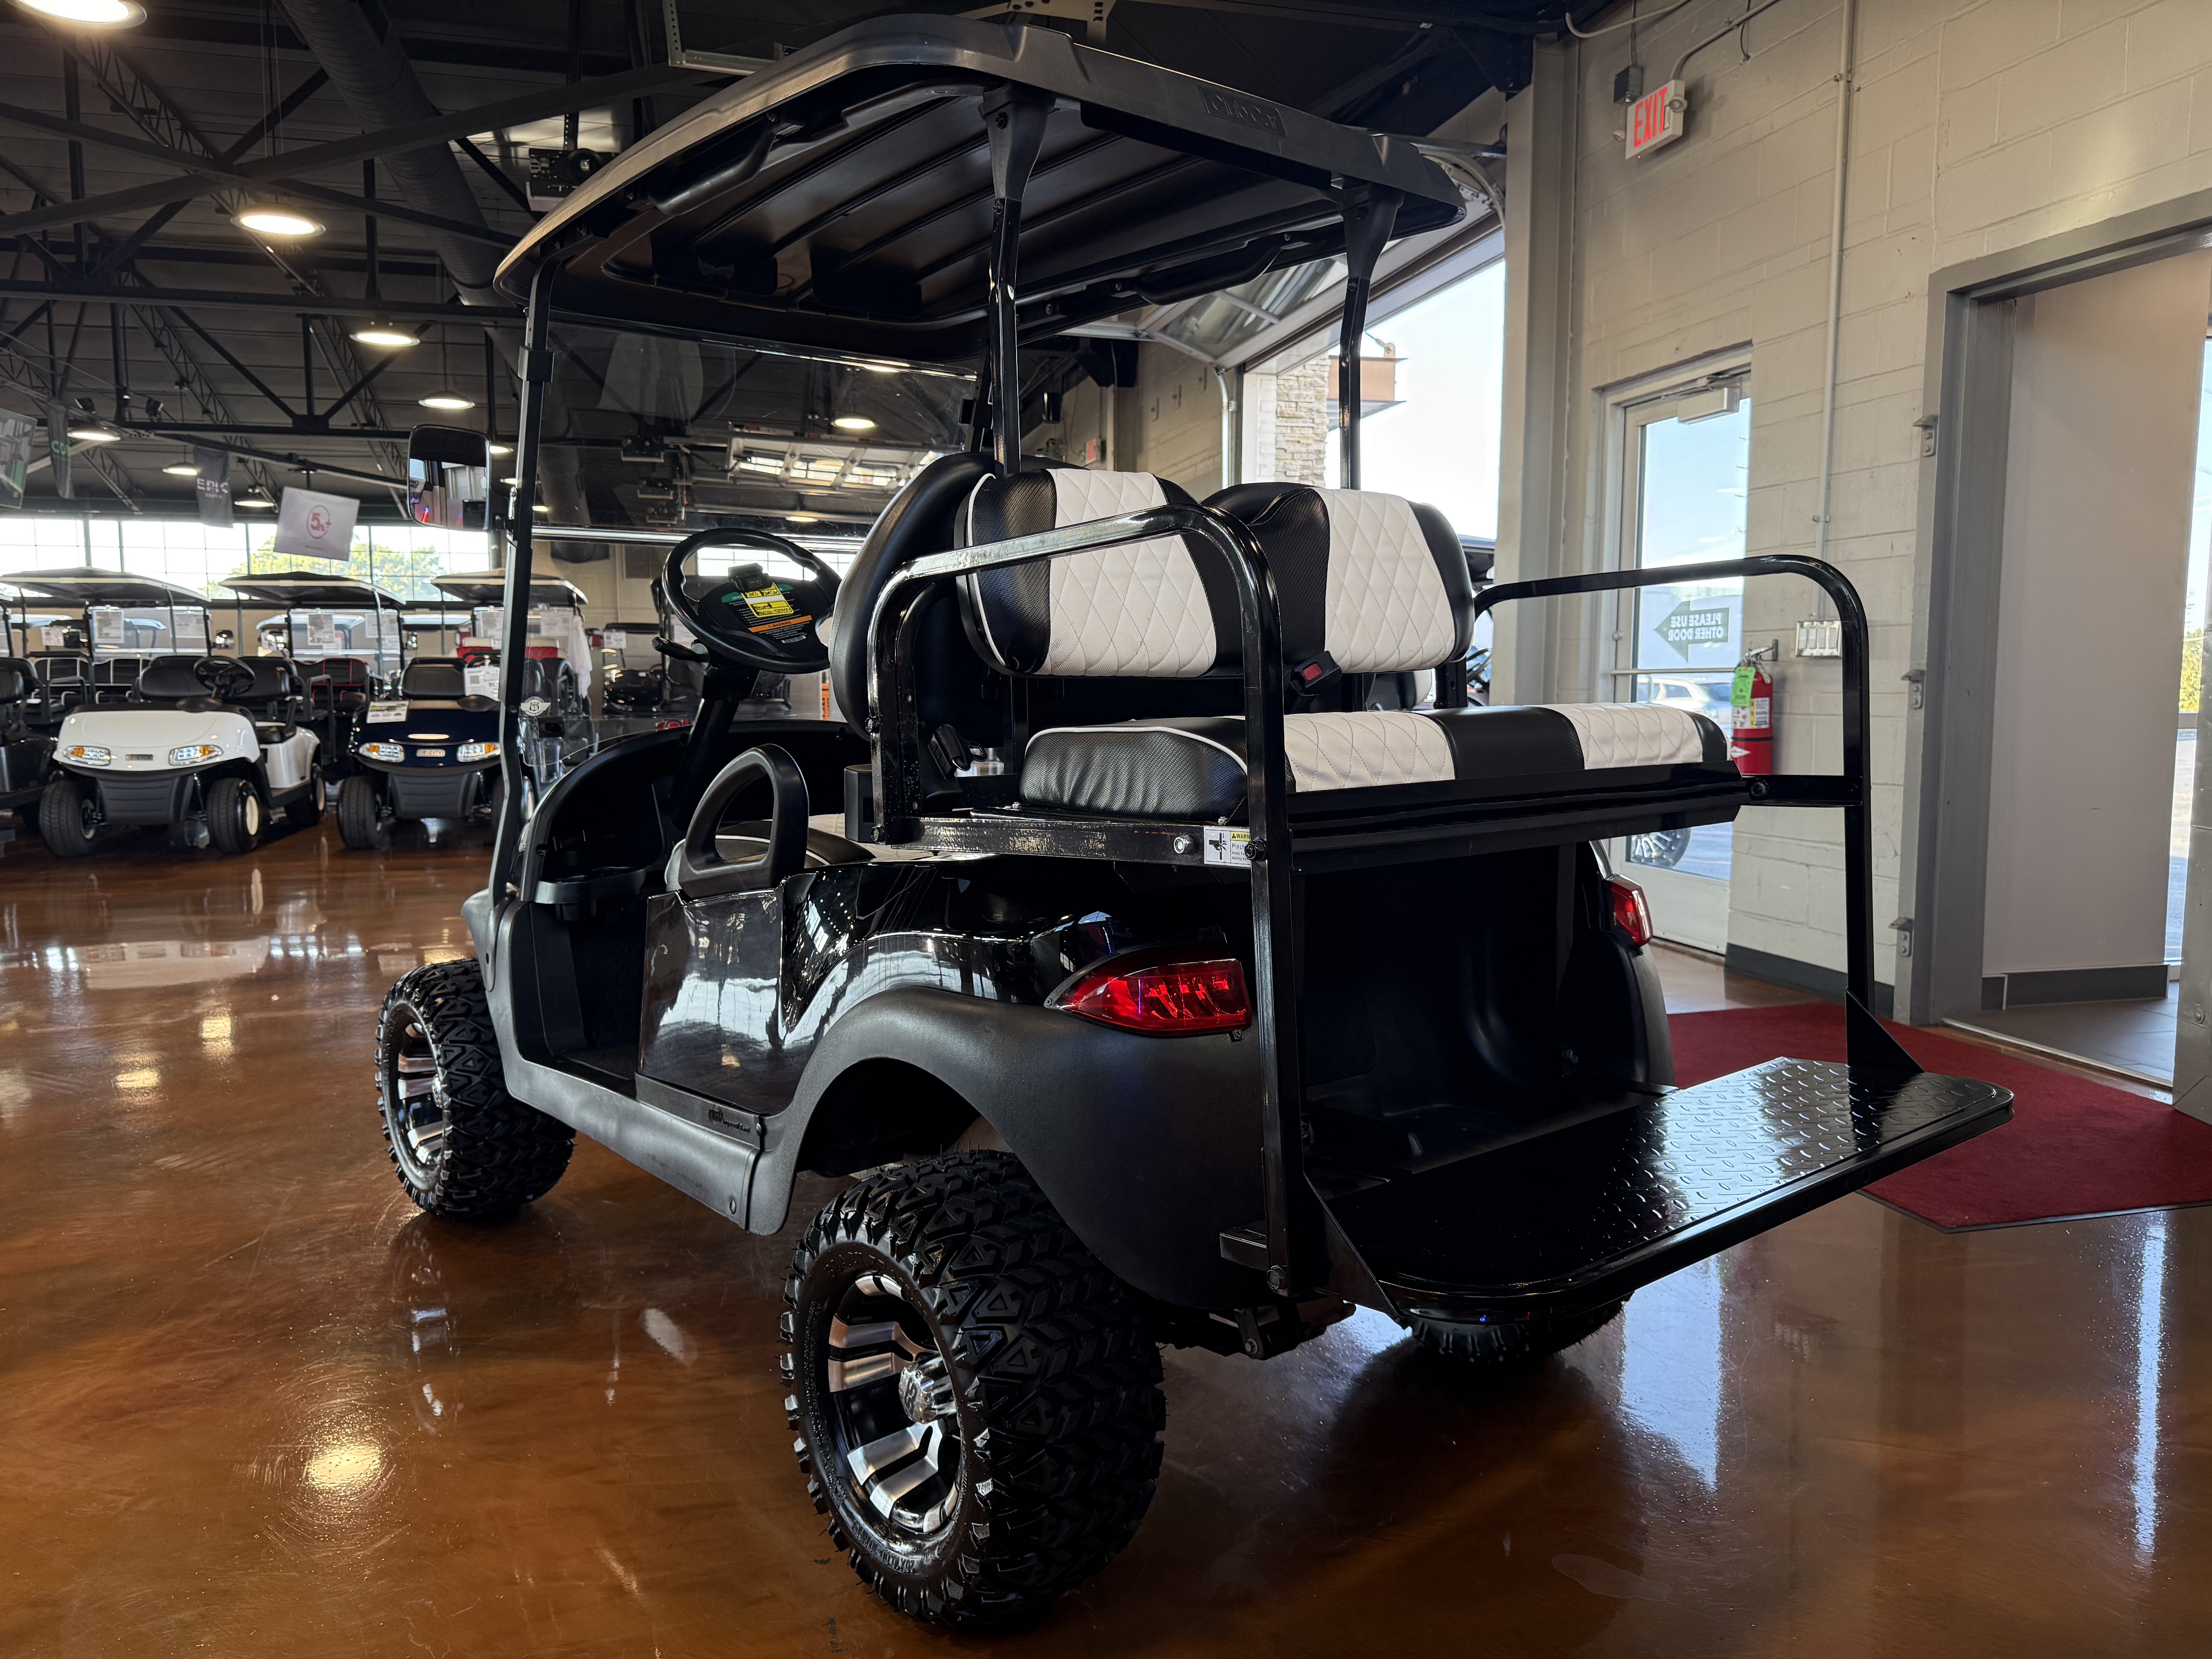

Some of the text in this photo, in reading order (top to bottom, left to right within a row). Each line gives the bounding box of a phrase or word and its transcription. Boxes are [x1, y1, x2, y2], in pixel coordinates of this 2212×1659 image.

[1211, 95, 1277, 130] Club Car
[1634, 87, 1668, 148] EXIT
[197, 478, 229, 494] EPIC
